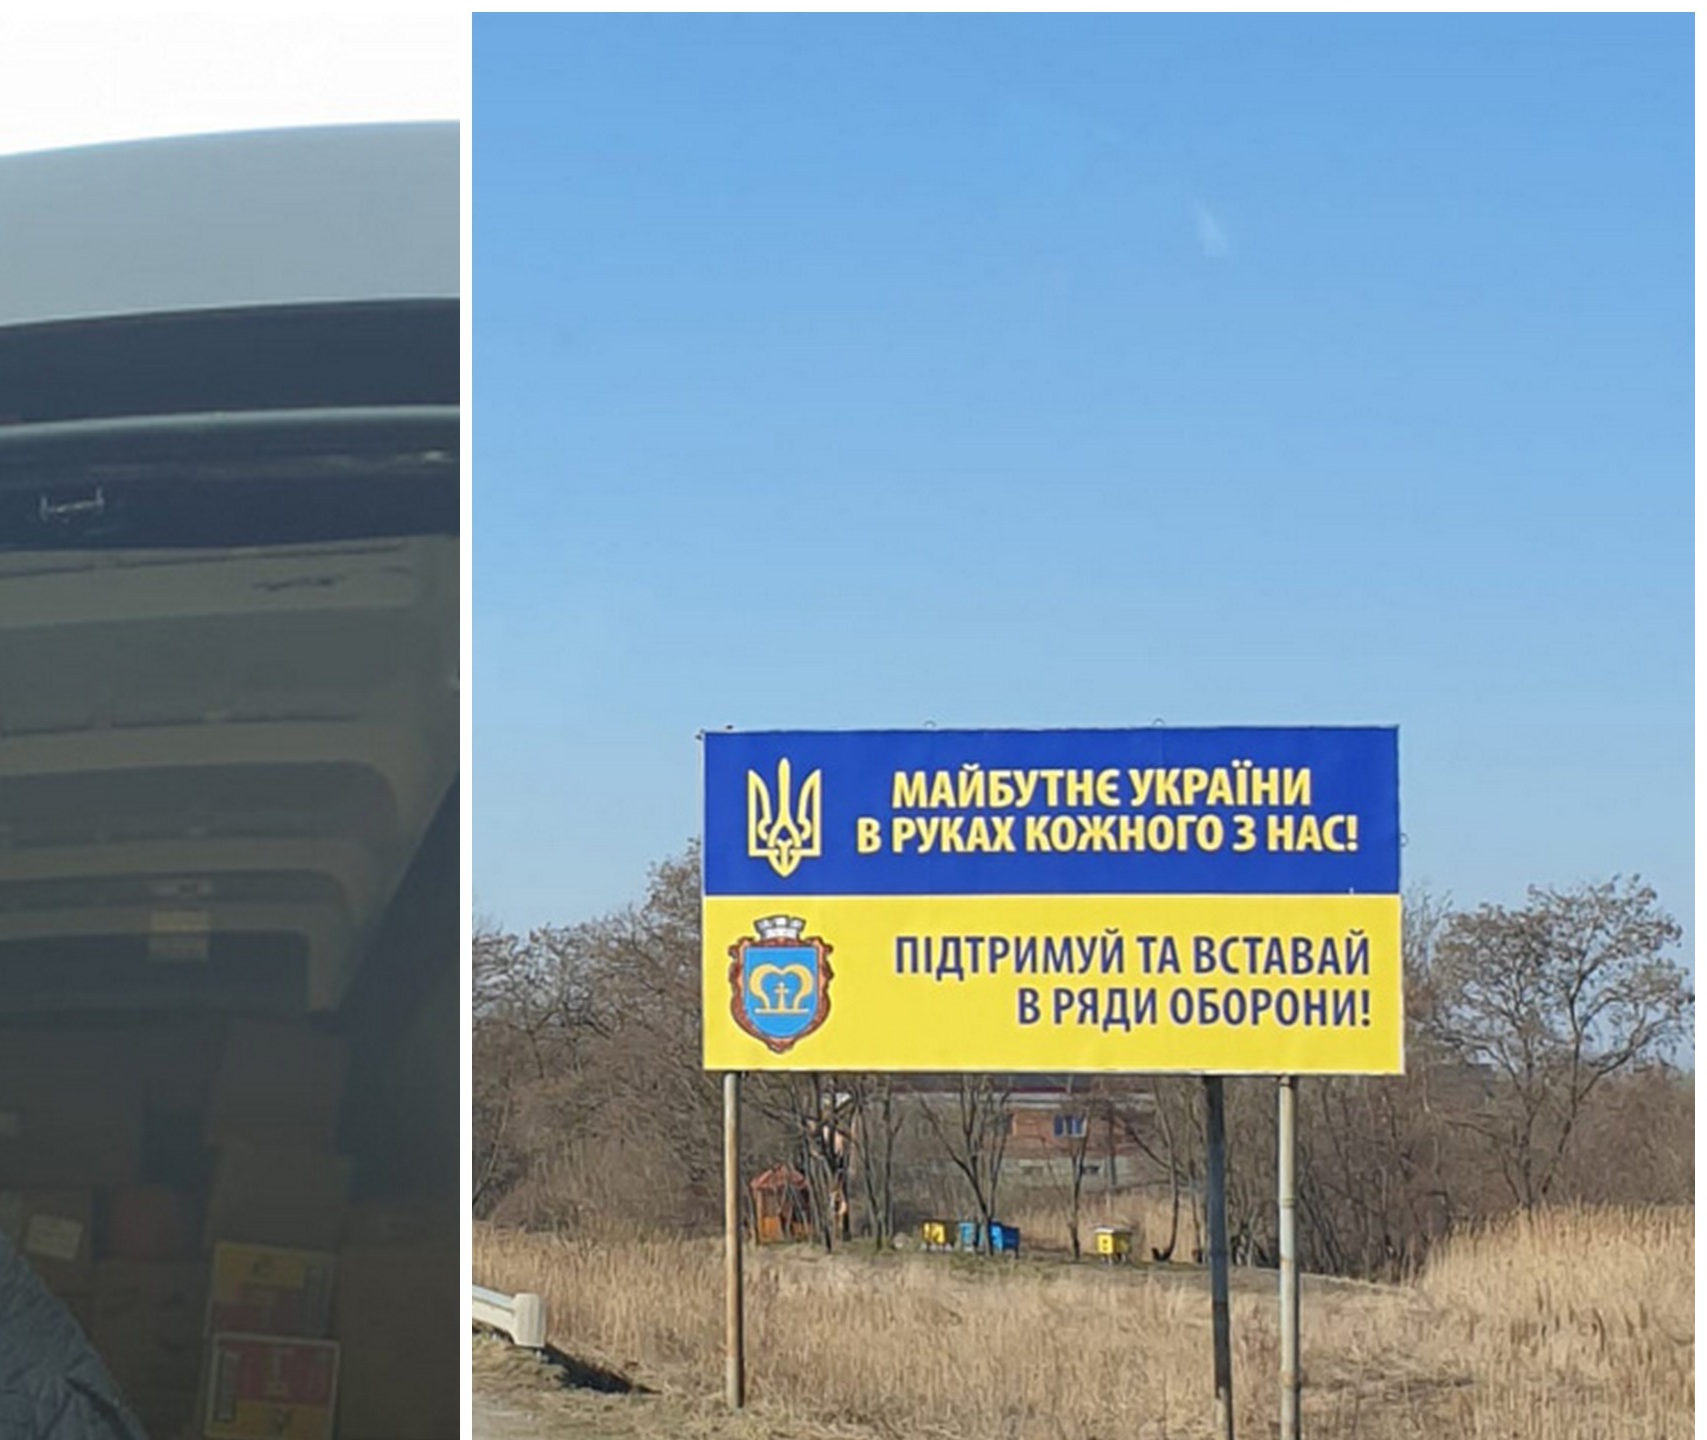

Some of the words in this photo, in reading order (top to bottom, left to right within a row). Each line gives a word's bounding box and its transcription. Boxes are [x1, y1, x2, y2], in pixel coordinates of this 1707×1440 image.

[891, 762, 1121, 809] МАЙБУТНЄ
[1128, 758, 1311, 807] УКРАЇНИ
[855, 816, 883, 854] В
[891, 815, 1016, 854] РУКАХ
[1024, 813, 1225, 853] КОЖНОГО
[1232, 813, 1257, 853] З
[1267, 813, 1359, 852] НАС!
[895, 926, 1125, 983] ПІДТРИМУЙ
[1135, 935, 1182, 974] ТА
[1192, 928, 1370, 976] ВСТАВАЙ
[1017, 986, 1042, 1026] В
[1053, 986, 1158, 1034] РЯДИ
[1169, 986, 1371, 1028] ОБОРОНИ!
